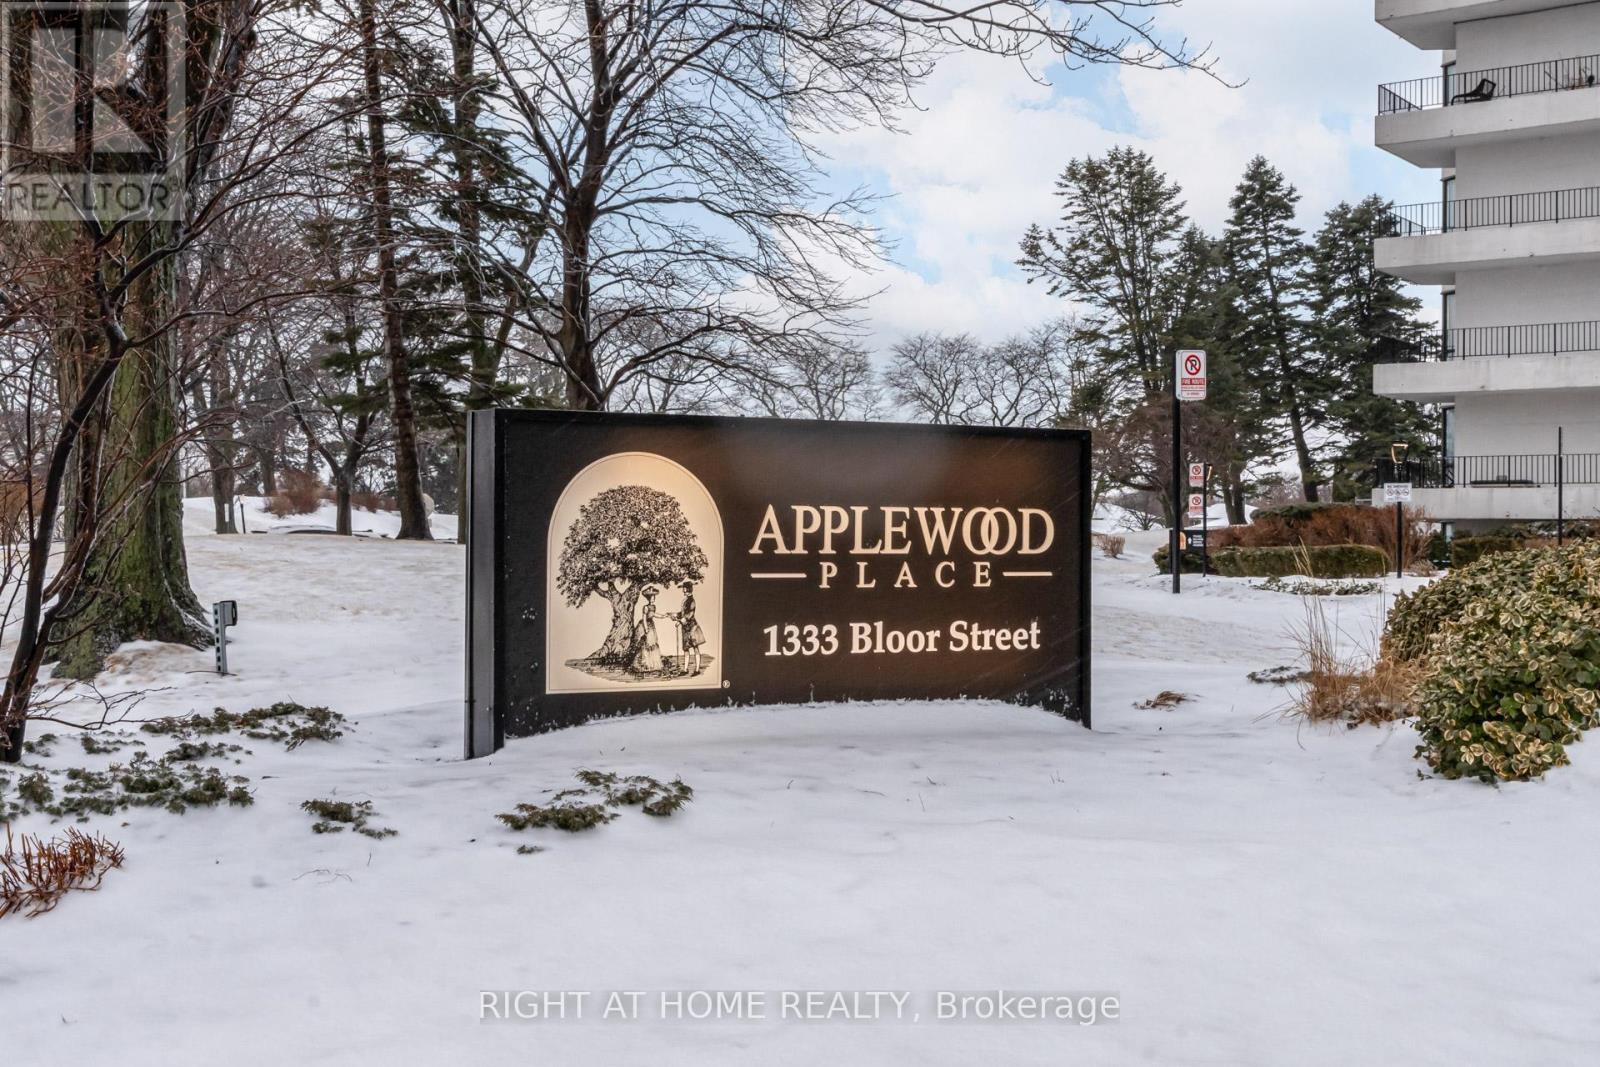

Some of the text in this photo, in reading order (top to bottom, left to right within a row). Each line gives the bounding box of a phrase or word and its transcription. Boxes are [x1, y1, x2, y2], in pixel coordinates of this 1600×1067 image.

[749, 504, 1055, 555] APPLEWOOD
[819, 561, 992, 589] PLACE
[763, 620, 1041, 656] 1333 Bloor Street
